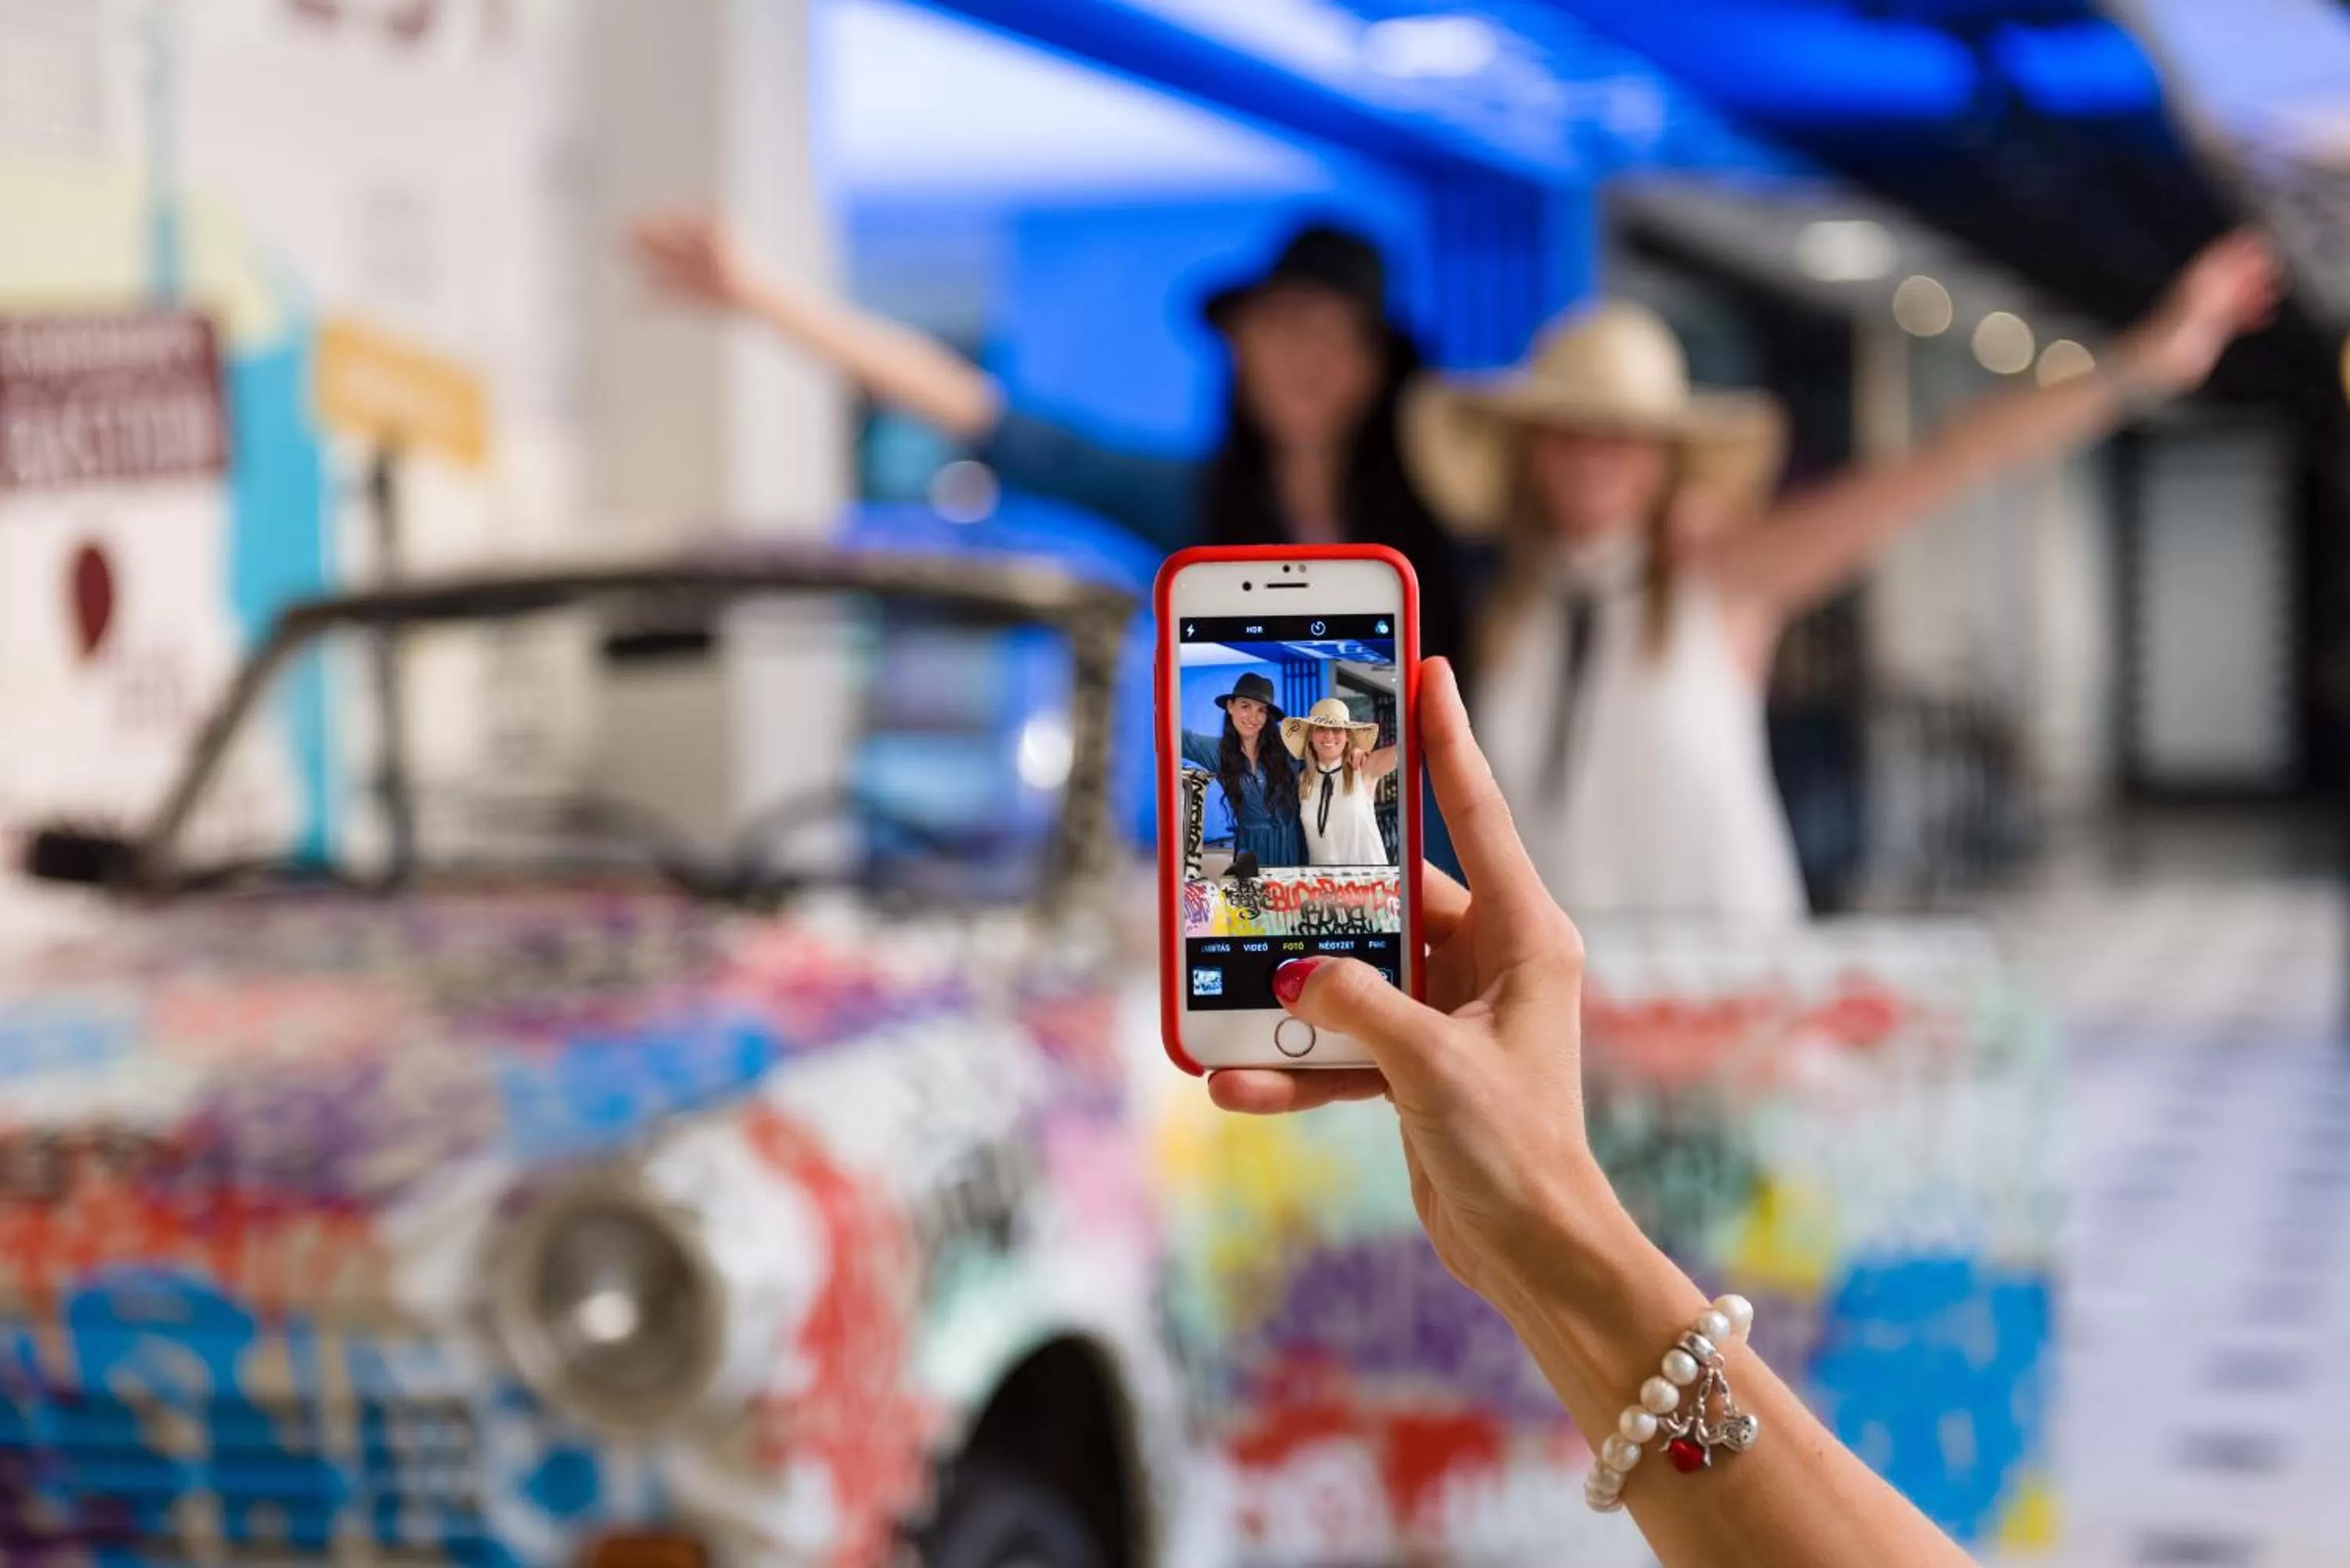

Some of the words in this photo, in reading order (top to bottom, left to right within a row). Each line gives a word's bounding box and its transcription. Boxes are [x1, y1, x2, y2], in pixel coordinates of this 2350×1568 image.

[1243, 941, 1268, 952] VIDEÓ
[1282, 941, 1304, 950] FOTÓ
[1318, 940, 1354, 950] NÉGYZET
